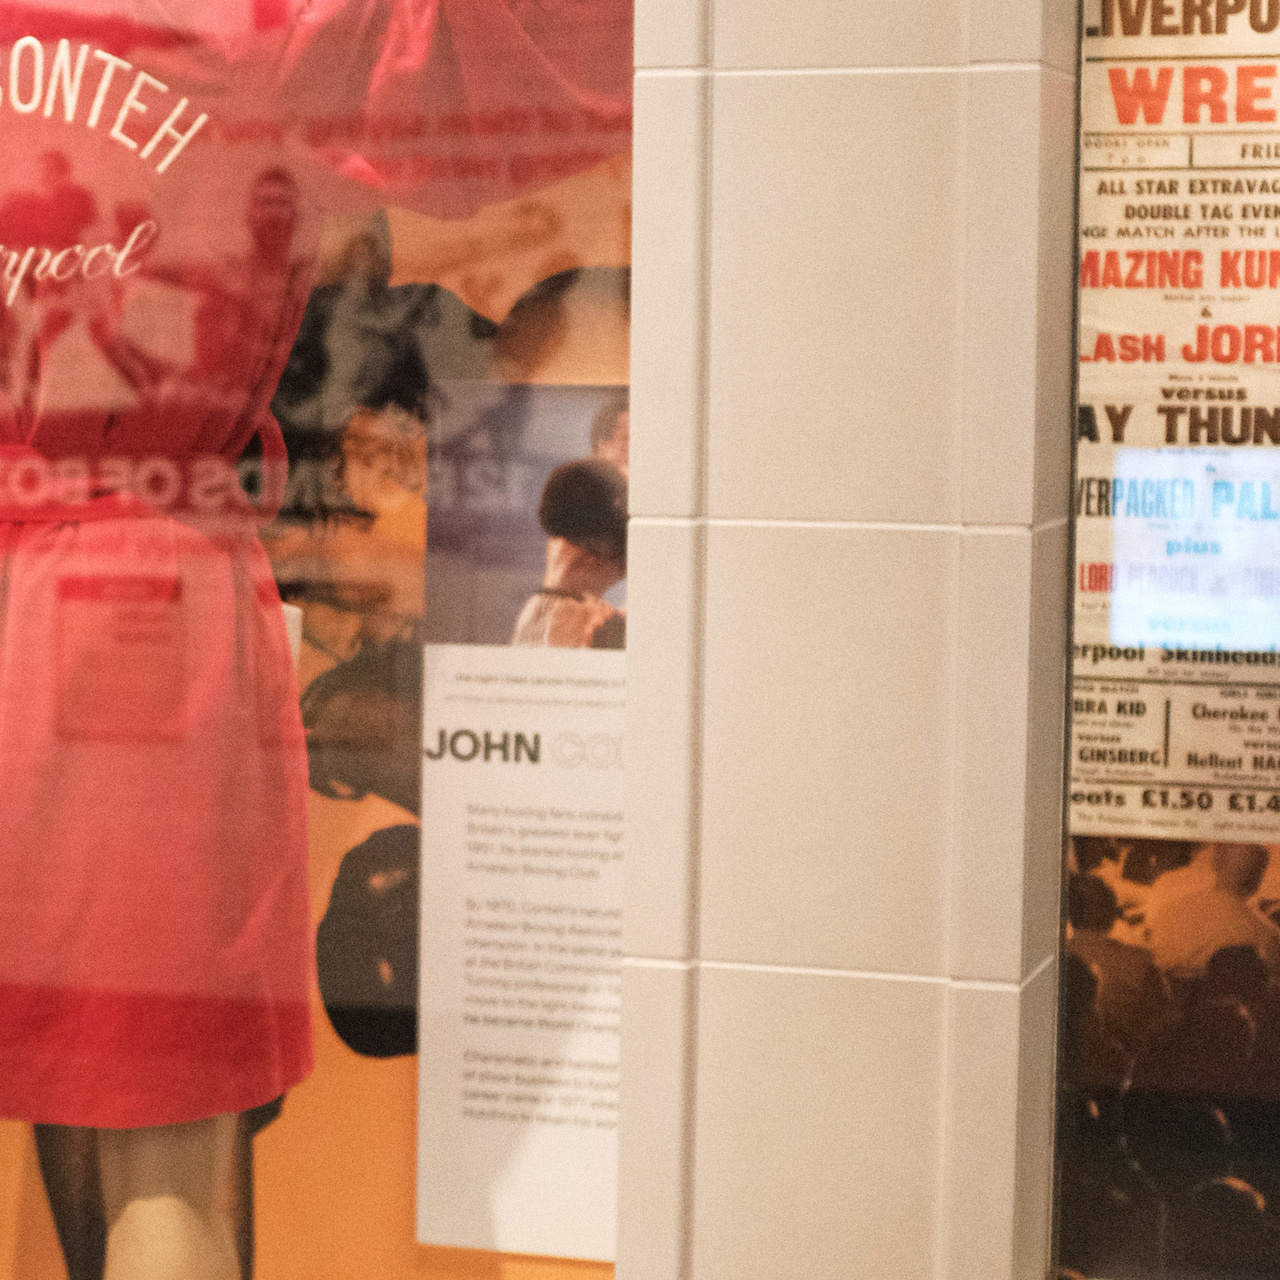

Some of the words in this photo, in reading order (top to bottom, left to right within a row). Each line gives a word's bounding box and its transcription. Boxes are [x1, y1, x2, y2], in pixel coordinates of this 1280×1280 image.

[1108, 65, 1278, 125] WRE
[1097, 179, 1127, 196] ALL
[1135, 179, 1180, 195] STAR
[1124, 204, 1192, 221] DOUBLE
[1200, 204, 1235, 220] TAG
[1117, 226, 1176, 238] MATCH
[1184, 226, 1231, 238] AFTER
[1239, 226, 1267, 238] THE
[1200, 305, 1214, 319] &
[1182, 324, 1280, 364] JOR
[1161, 387, 1248, 402] versus
[1166, 536, 1222, 556] plus
[1117, 700, 1147, 718] KID
[1192, 702, 1269, 721] Cherokee
[424, 728, 542, 765] JOHN
[552, 731, 624, 771] CO
[1078, 745, 1161, 766] GINSBERG
[1142, 788, 1214, 812] £1.50
